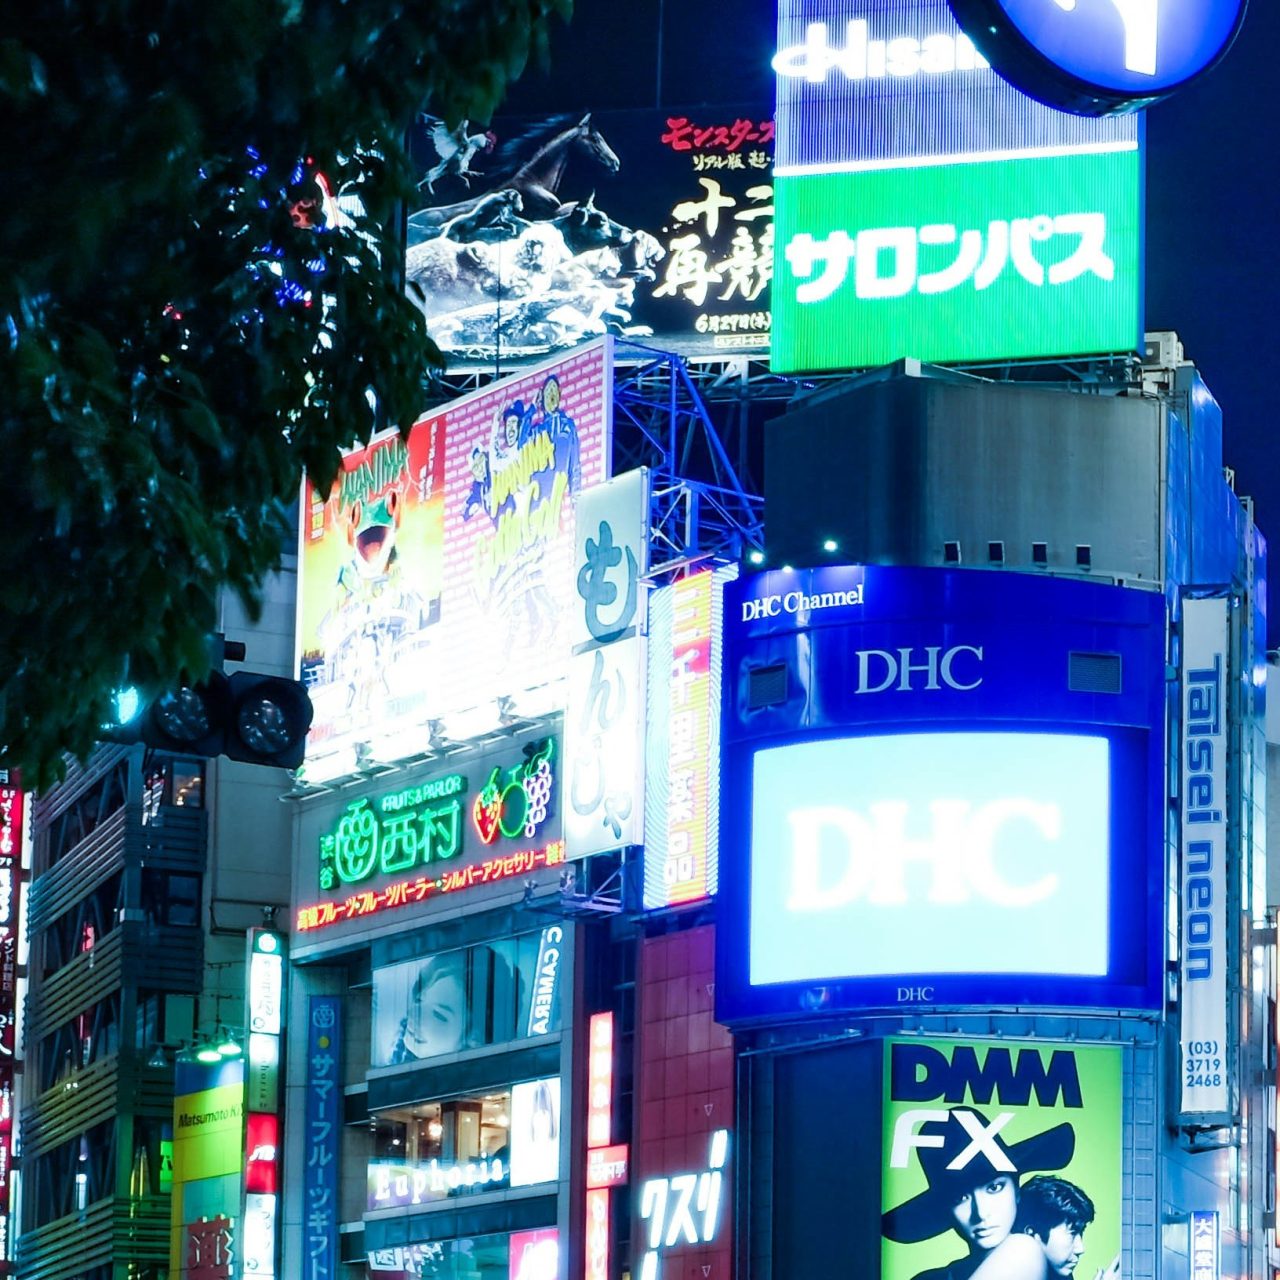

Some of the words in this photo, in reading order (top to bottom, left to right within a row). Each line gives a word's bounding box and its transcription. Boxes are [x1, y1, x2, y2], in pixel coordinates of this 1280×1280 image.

[785, 211, 1115, 303] サロンパス
[741, 596, 781, 622] DHC
[783, 584, 864, 615] Channel
[571, 520, 639, 839] もんじゃ
[855, 644, 984, 694] DHC
[1187, 653, 1222, 824] Taisei
[381, 799, 460, 874] 西村
[786, 797, 1061, 912] DHC
[1187, 839, 1213, 982] neon
[897, 986, 934, 1002] DHC
[890, 1044, 1083, 1108] DMM
[1186, 1057, 1221, 1073] 3719
[1187, 1040, 1220, 1057] (03)
[1186, 1073, 1222, 1089] 2468
[890, 1108, 1018, 1172] FX
[376, 1152, 505, 1206] Euphoria
